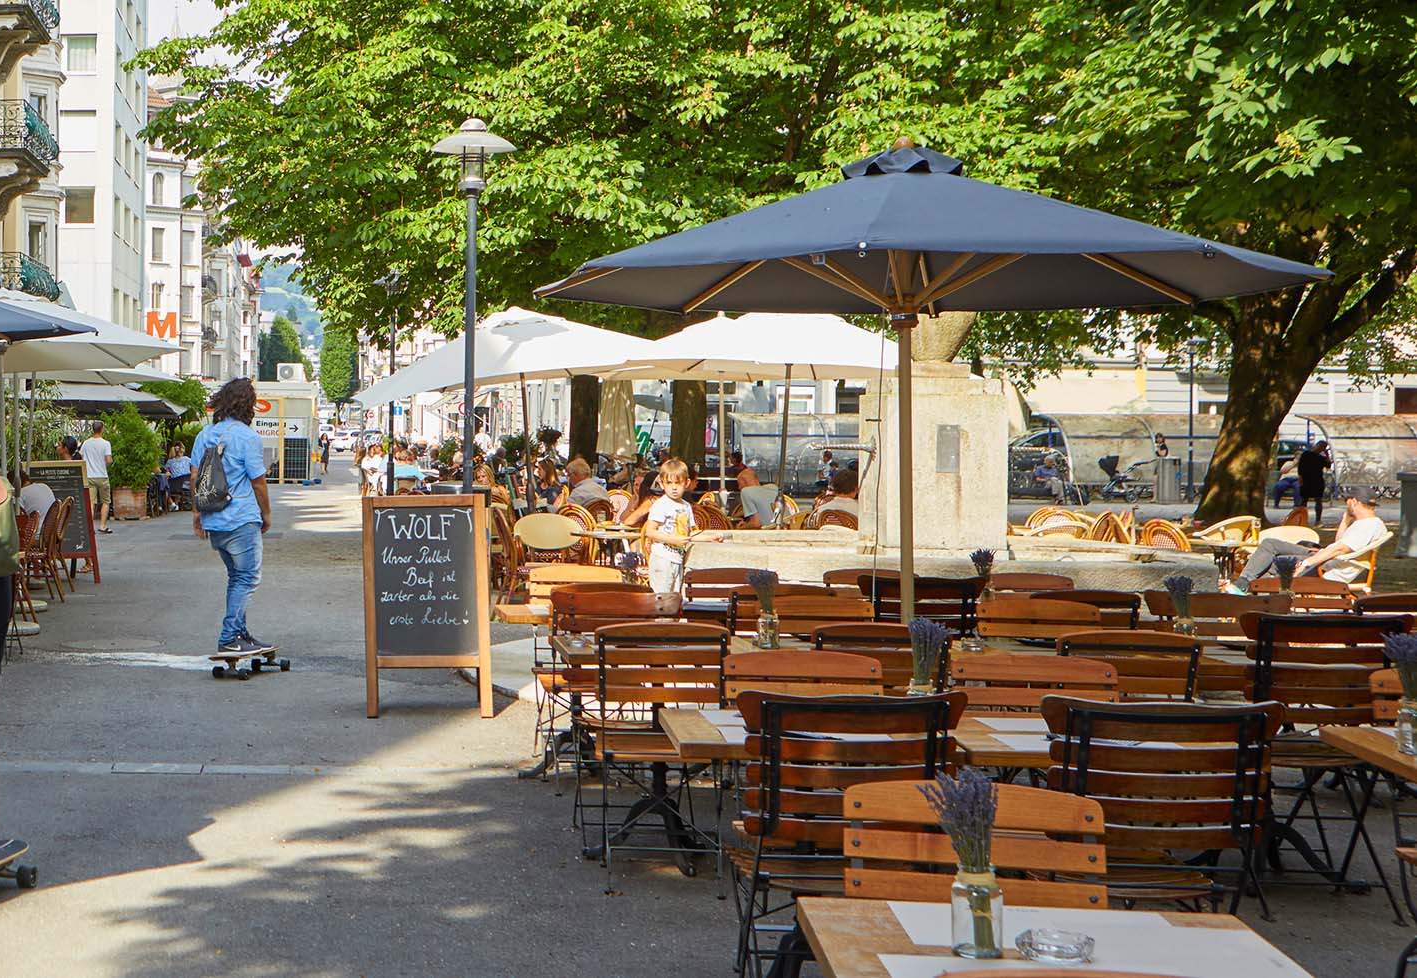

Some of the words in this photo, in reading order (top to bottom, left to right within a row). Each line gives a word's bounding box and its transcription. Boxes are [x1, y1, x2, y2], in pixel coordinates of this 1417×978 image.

[146, 311, 177, 339] M
[387, 513, 456, 541] WOLF
[381, 546, 413, 565] Unser
[415, 545, 452, 565] Pulled
[442, 570, 456, 582] ist
[419, 590, 437, 601] als
[441, 590, 460, 601] die
[389, 613, 415, 626] erste
